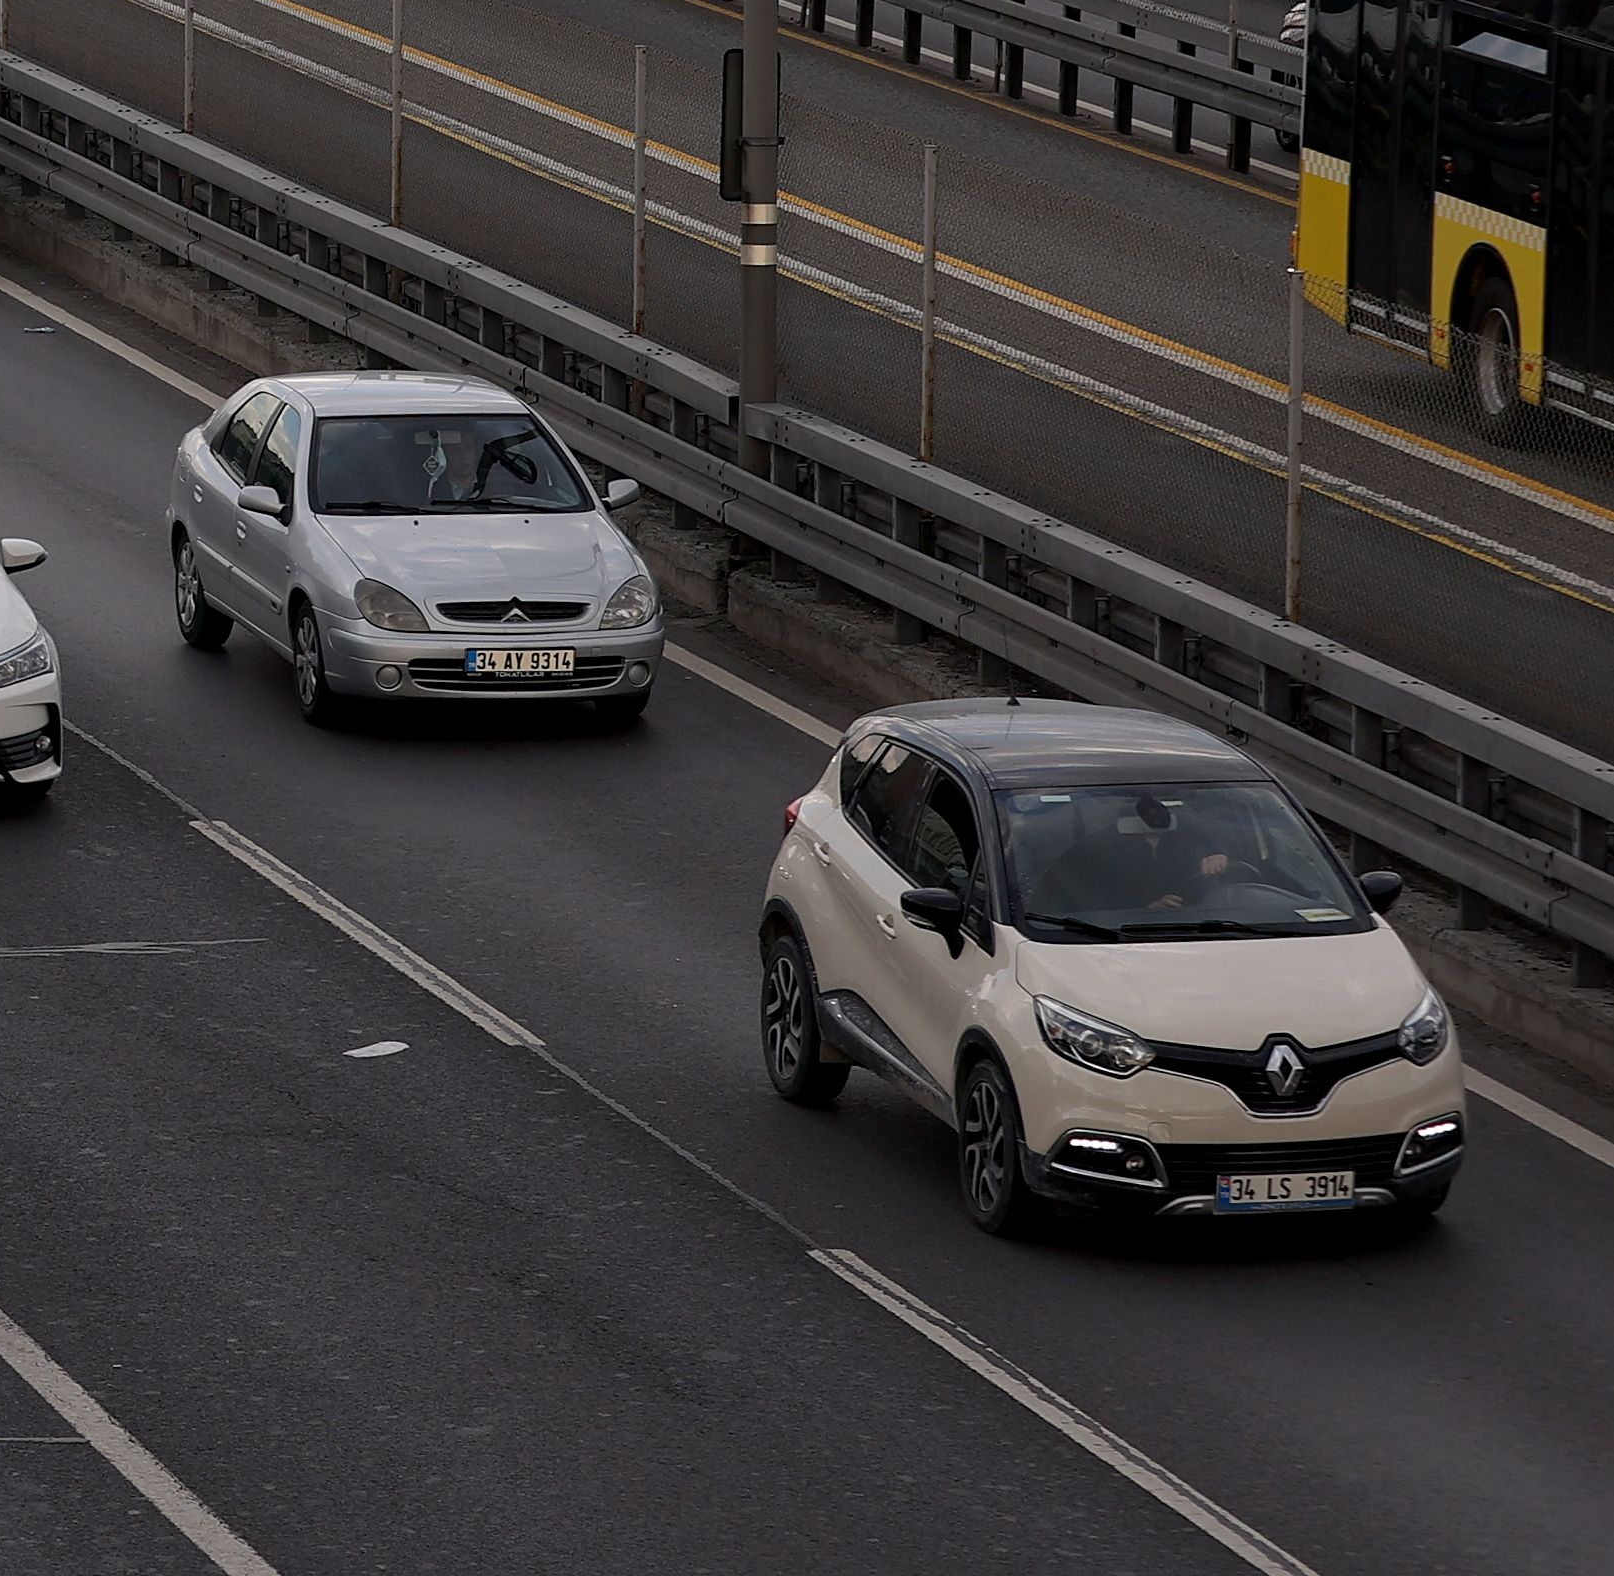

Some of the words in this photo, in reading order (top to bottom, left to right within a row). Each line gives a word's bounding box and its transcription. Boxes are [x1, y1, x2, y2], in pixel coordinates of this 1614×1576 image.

[476, 652, 496, 670] 34
[503, 652, 524, 669] AY
[531, 651, 571, 669] 9314
[1232, 1179, 1255, 1201] 34
[1267, 1177, 1291, 1199] LS
[1305, 1175, 1349, 1199] 3914
